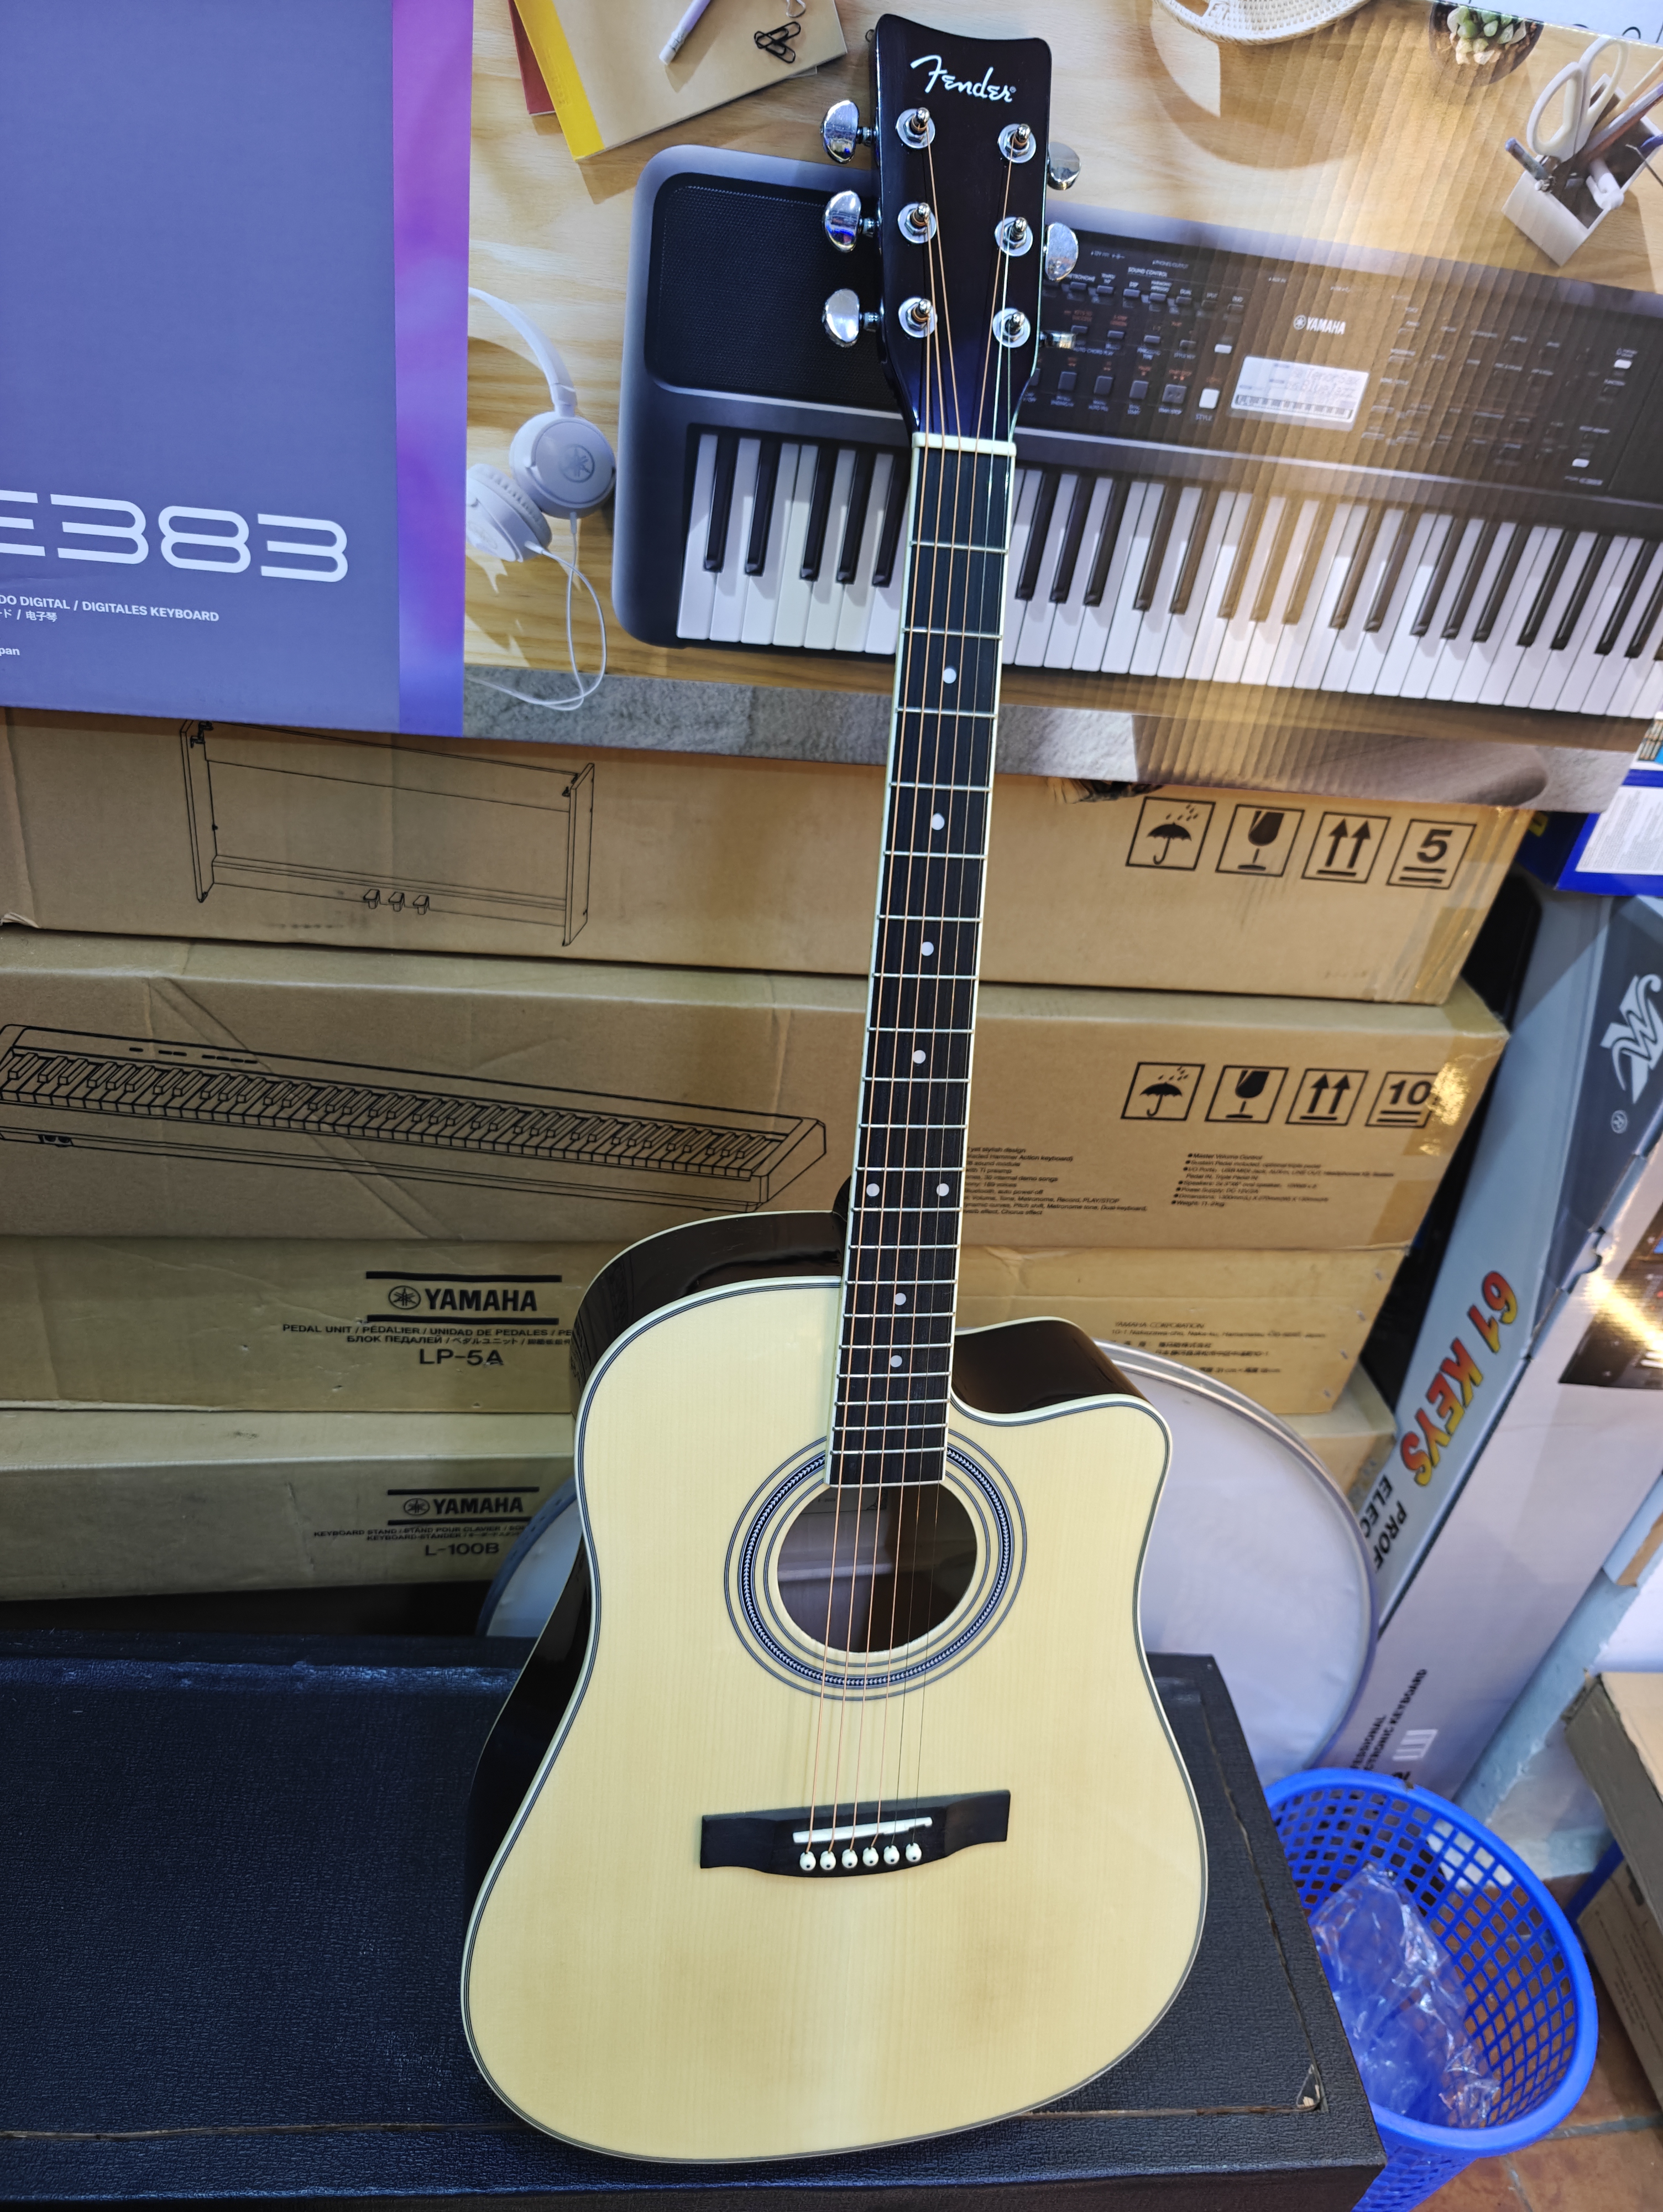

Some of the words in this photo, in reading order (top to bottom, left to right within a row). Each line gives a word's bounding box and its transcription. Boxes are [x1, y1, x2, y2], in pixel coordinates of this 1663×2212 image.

[910, 54, 1013, 102] Fender
[1306, 316, 1346, 335] YAMAHA
[19, 596, 70, 609] DIGITAL
[82, 601, 148, 615] DIGITALES
[150, 607, 219, 622] KEYBOARD
[1416, 829, 1453, 864] 5
[1389, 1079, 1432, 1105] 10
[425, 1288, 537, 1311] YAMAHA
[1467, 1270, 1518, 1354] 61
[283, 1324, 322, 1333] PEDAL
[430, 1328, 473, 1336] UNIDAD
[385, 1335, 442, 1344] ПЕДАЛЕЙ
[419, 1348, 504, 1366] LP-5A
[1400, 1337, 1483, 1487] KEYS
[433, 1496, 524, 1515] YAMAHA
[1373, 1500, 1408, 1572] PROF
[425, 1542, 500, 1556] L-100B
